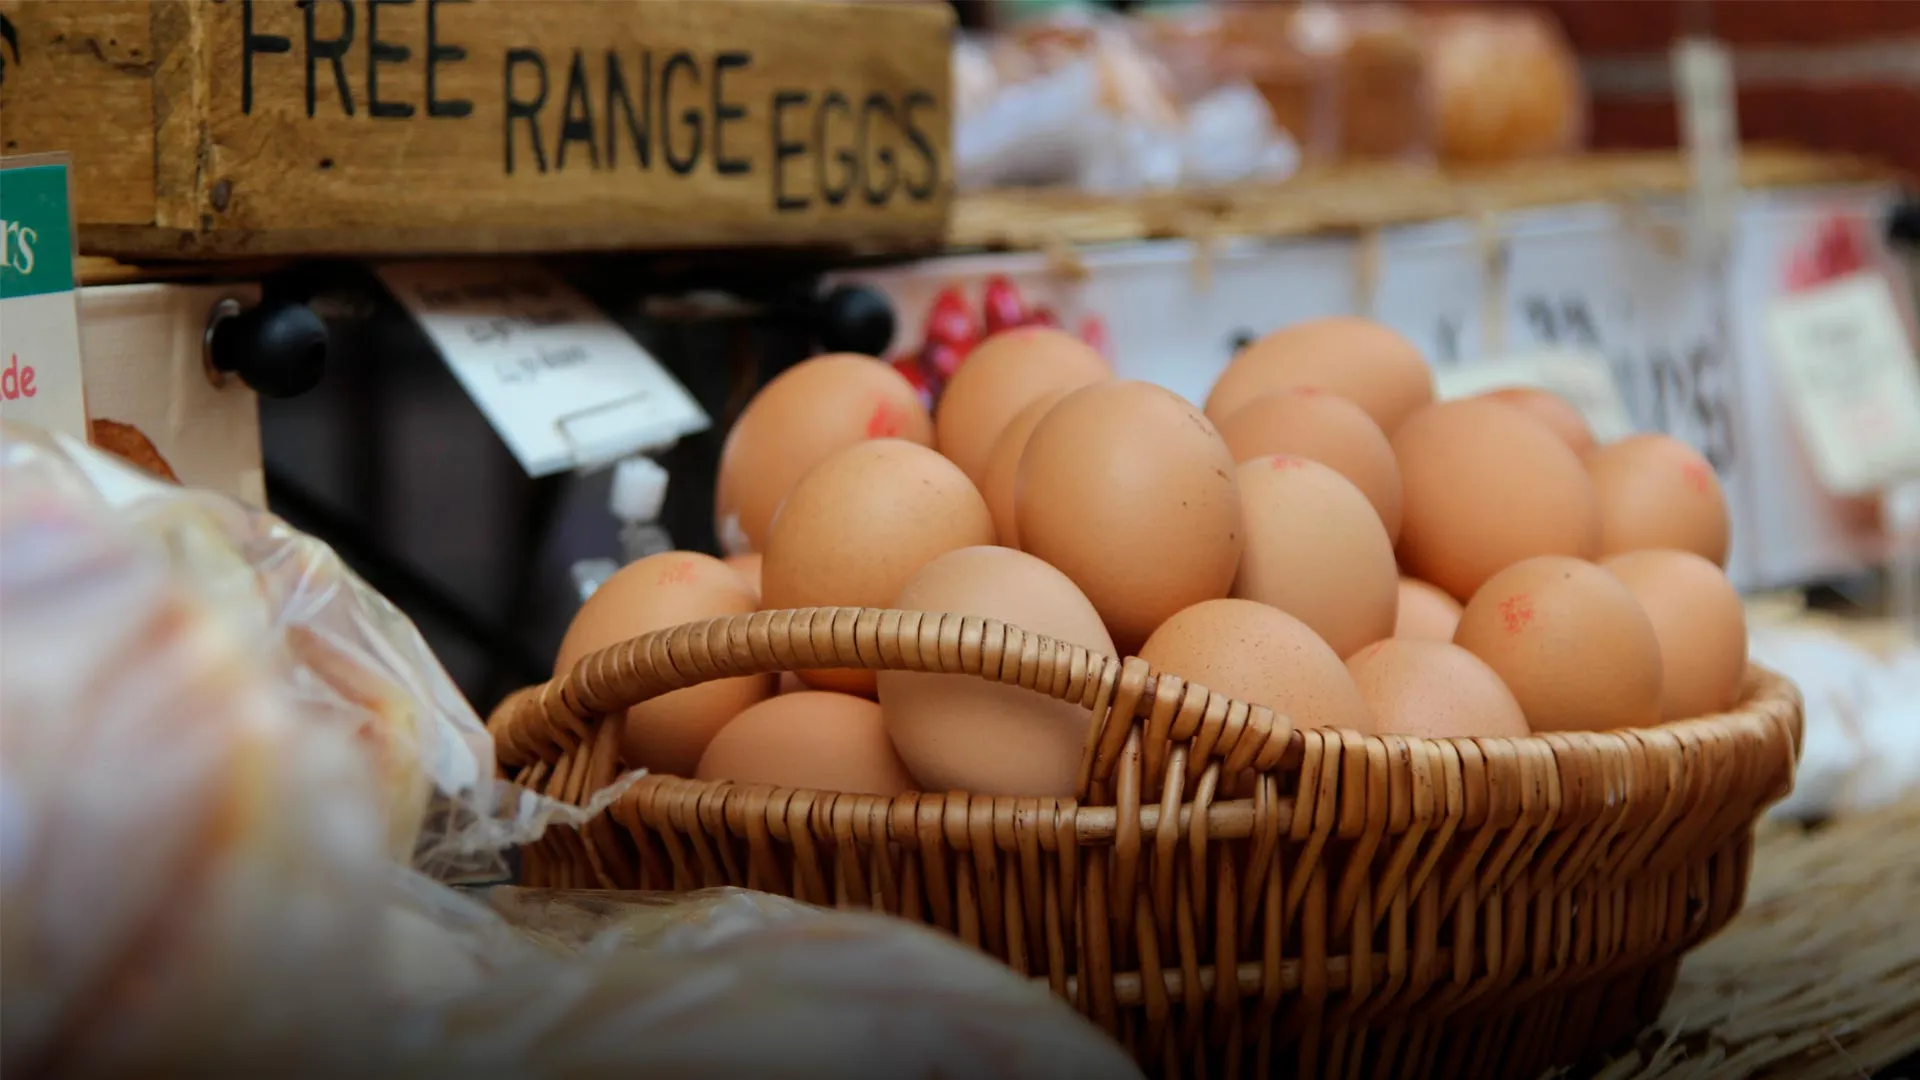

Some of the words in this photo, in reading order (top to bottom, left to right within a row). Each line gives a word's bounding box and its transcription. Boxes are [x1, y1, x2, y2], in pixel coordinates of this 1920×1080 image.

[241, 0, 474, 118] FREE
[504, 46, 751, 176] RANGE
[771, 90, 939, 212] EGGS
[0, 353, 38, 401] de
